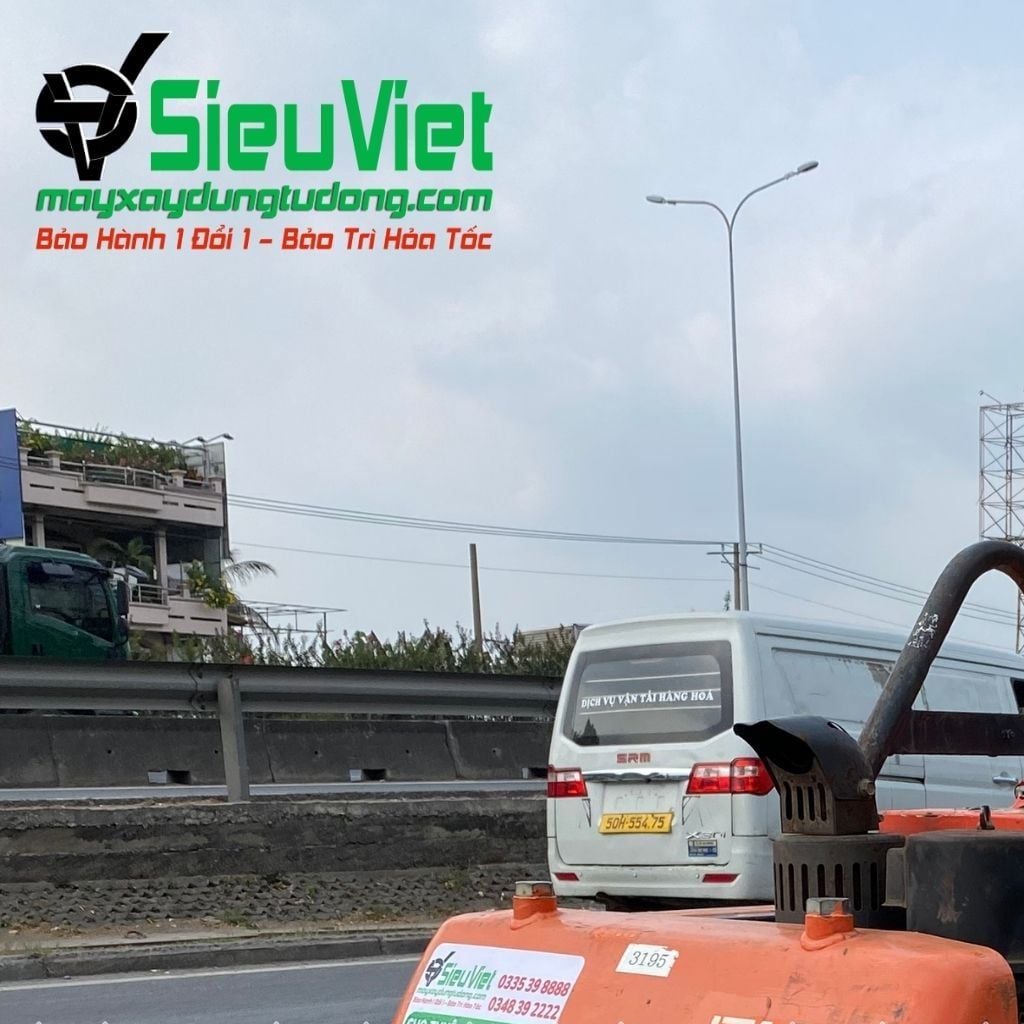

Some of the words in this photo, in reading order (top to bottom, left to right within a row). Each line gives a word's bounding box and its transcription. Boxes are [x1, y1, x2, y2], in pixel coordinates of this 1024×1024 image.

[581, 696, 601, 709] DỊCH
[603, 695, 615, 707] VỤ
[618, 692, 637, 707] VẬN
[617, 753, 651, 764] SRM
[628, 950, 670, 969] 3195
[437, 962, 497, 991] SieuViet
[498, 974, 527, 991] 0335
[525, 978, 541, 993] 39
[540, 980, 571, 997] 8888
[487, 996, 516, 1014] 0348
[514, 999, 531, 1015] 39
[530, 1002, 560, 1020] 2222
